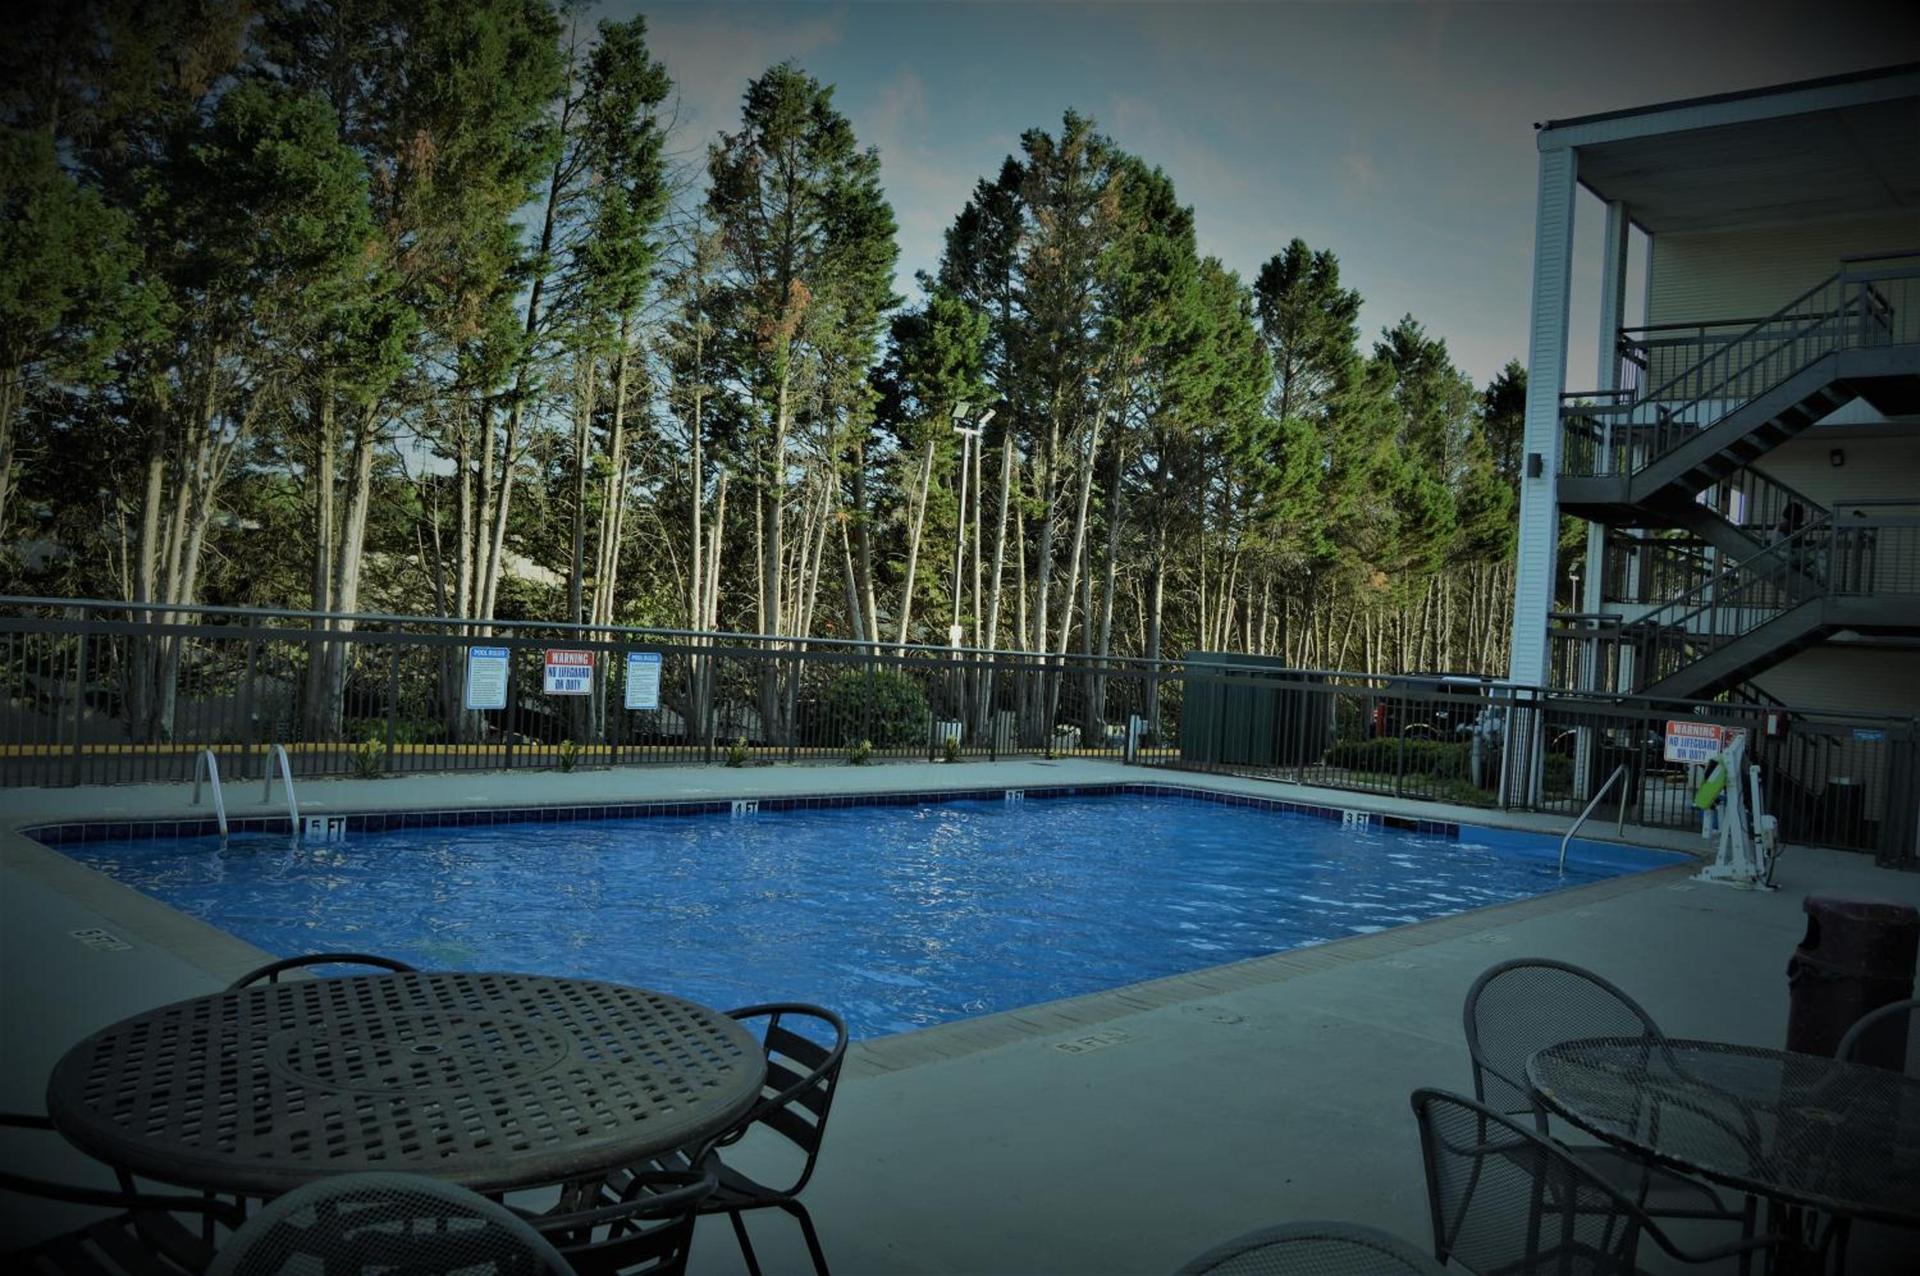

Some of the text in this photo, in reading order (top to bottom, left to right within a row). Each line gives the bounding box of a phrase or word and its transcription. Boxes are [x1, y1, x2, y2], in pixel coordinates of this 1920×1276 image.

[552, 651, 588, 664] WARNING
[548, 667, 589, 678] NO LIFEGUARD
[566, 679, 581, 690] DUTY
[1675, 722, 1715, 738] WARNING
[1681, 737, 1717, 750] LIFEGUARD
[1689, 749, 1706, 760] DUTY
[746, 802, 757, 814] FT
[1346, 812, 1367, 825] 3 FT
[327, 817, 345, 834] FT
